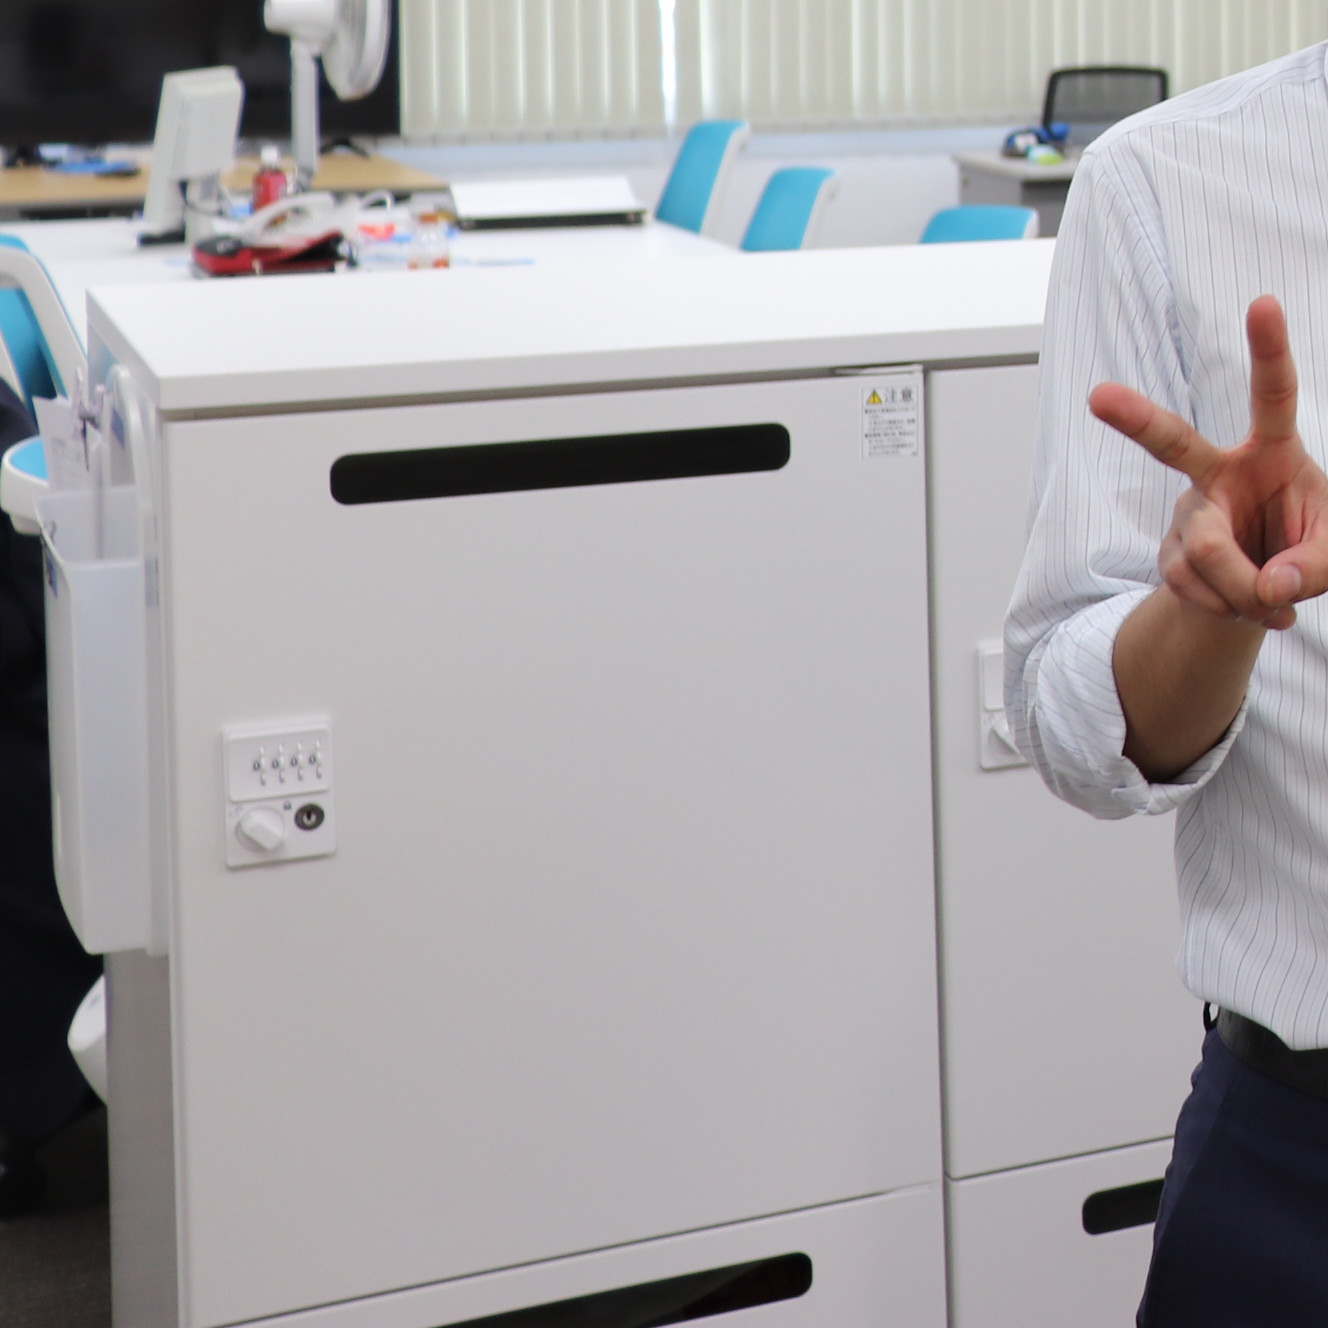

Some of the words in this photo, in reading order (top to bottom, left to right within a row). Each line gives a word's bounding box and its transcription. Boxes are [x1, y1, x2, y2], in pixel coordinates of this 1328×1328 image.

[253, 760, 260, 771] 0
[272, 759, 279, 769] 0
[291, 756, 298, 767] 0
[309, 754, 316, 765] 0
